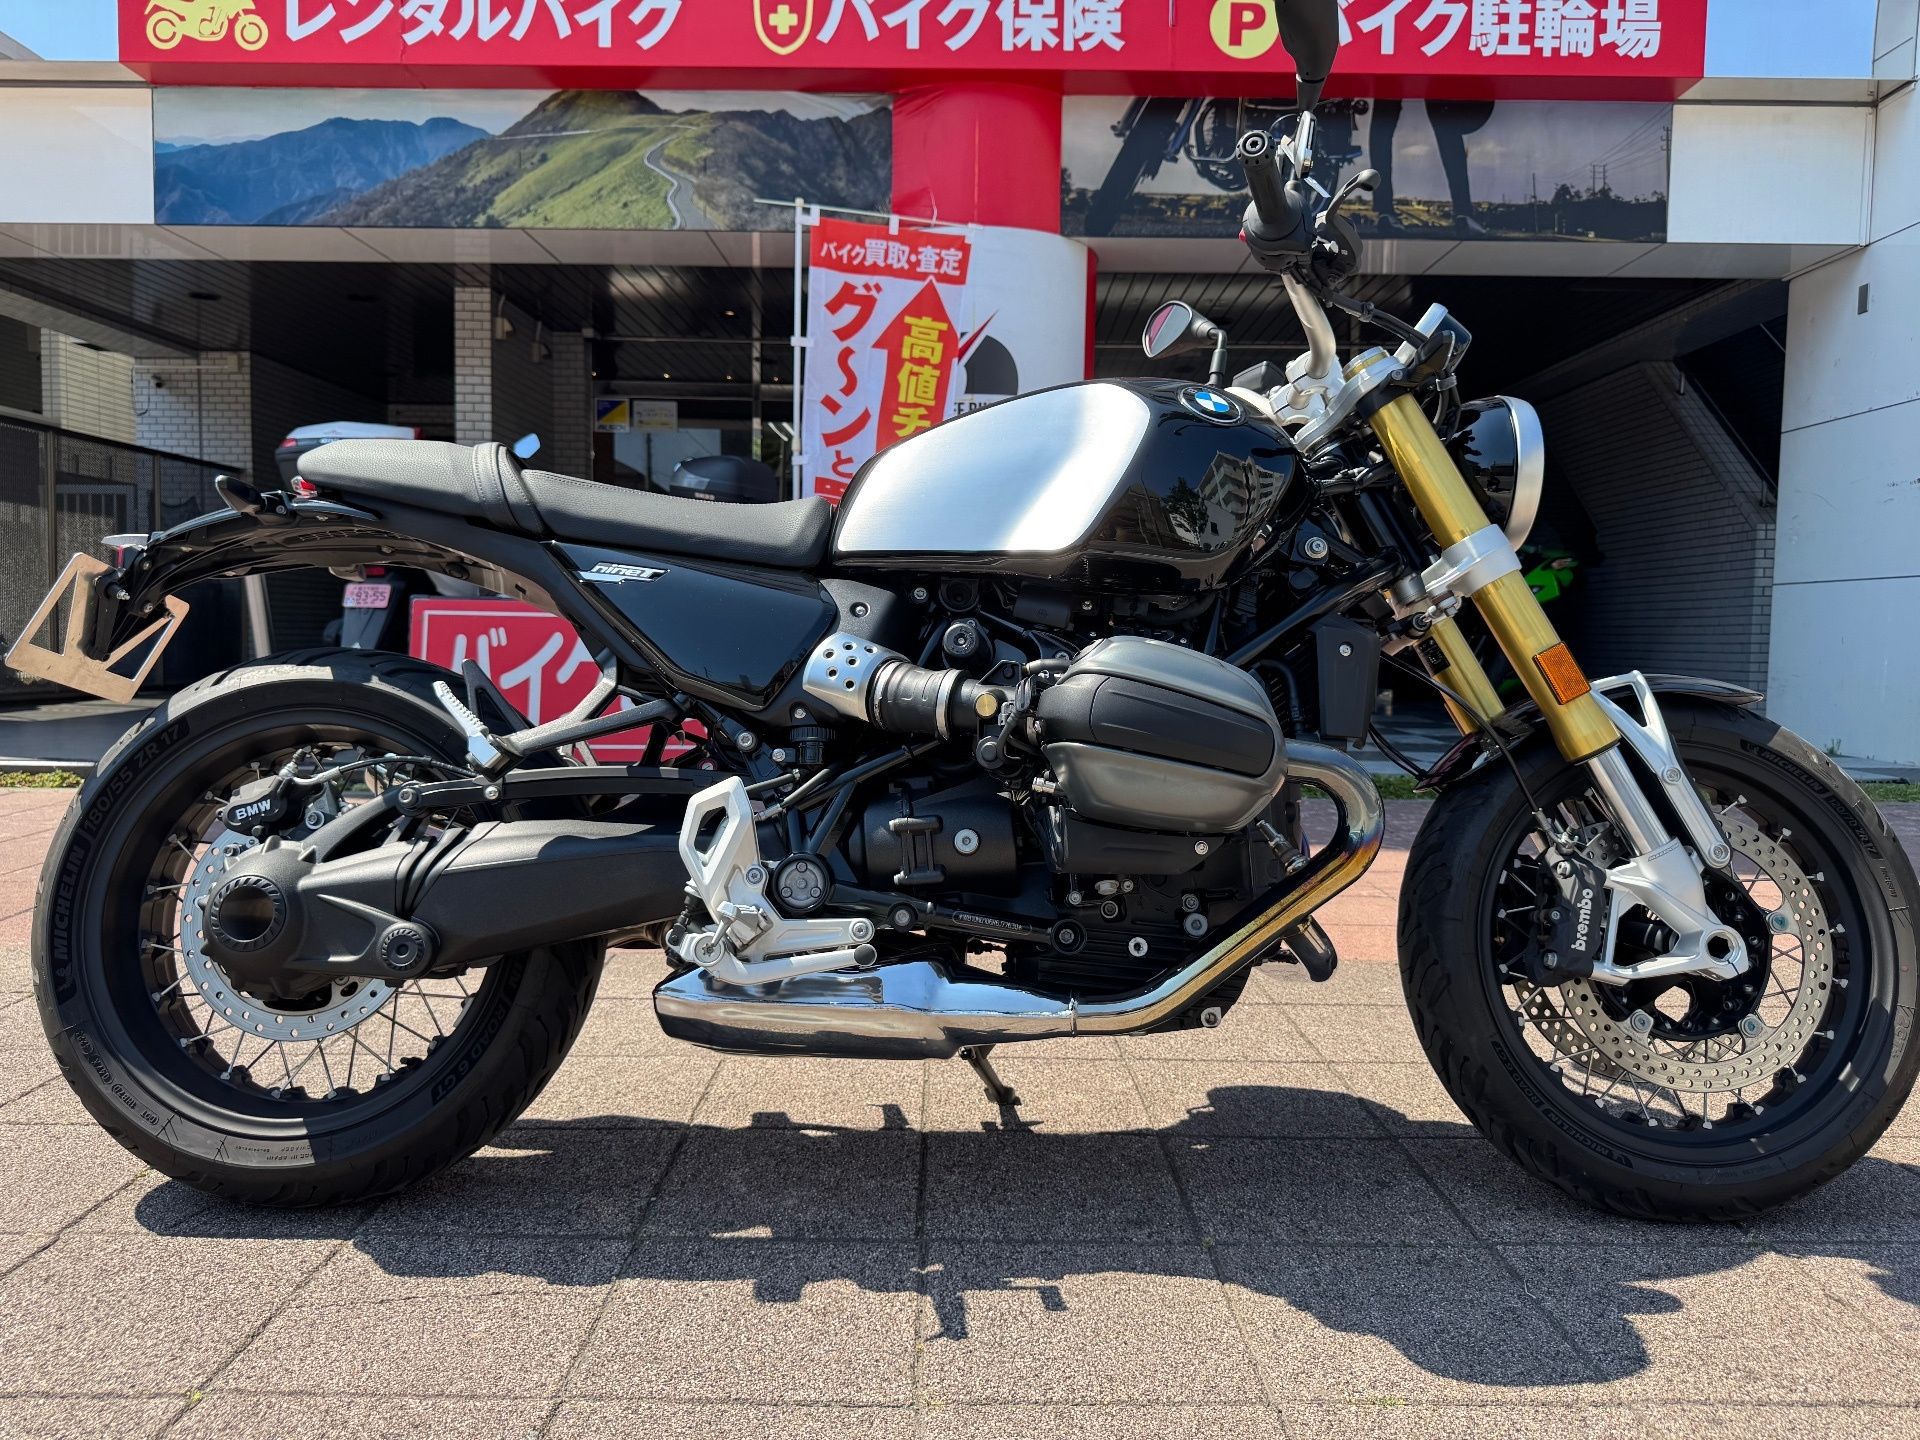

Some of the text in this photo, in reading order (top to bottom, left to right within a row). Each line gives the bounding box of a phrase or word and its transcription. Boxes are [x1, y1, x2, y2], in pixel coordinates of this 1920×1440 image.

[286, 0, 682, 50] レンタルバイク
[816, 0, 1125, 52] バイク保険
[1338, 0, 1662, 58] イク駐輪場
[820, 238, 963, 276] バイク買取・査定
[588, 562, 665, 578] nineT
[356, 591, 386, 602] 93-55
[236, 799, 271, 820] BMW
[1762, 752, 1823, 791] MICHELIN
[1829, 799, 1857, 827] 120/70
[1855, 827, 1869, 845] ZR
[54, 723, 181, 960] MICHELIN 180/55 ZR 17
[1571, 888, 1593, 951] brembo
[436, 1005, 506, 1098] ROAD 6 GT
[1496, 1046, 1508, 1061] GT
[1513, 1073, 1541, 1105] ROAD
[1547, 1111, 1610, 1157] MICHELIN
